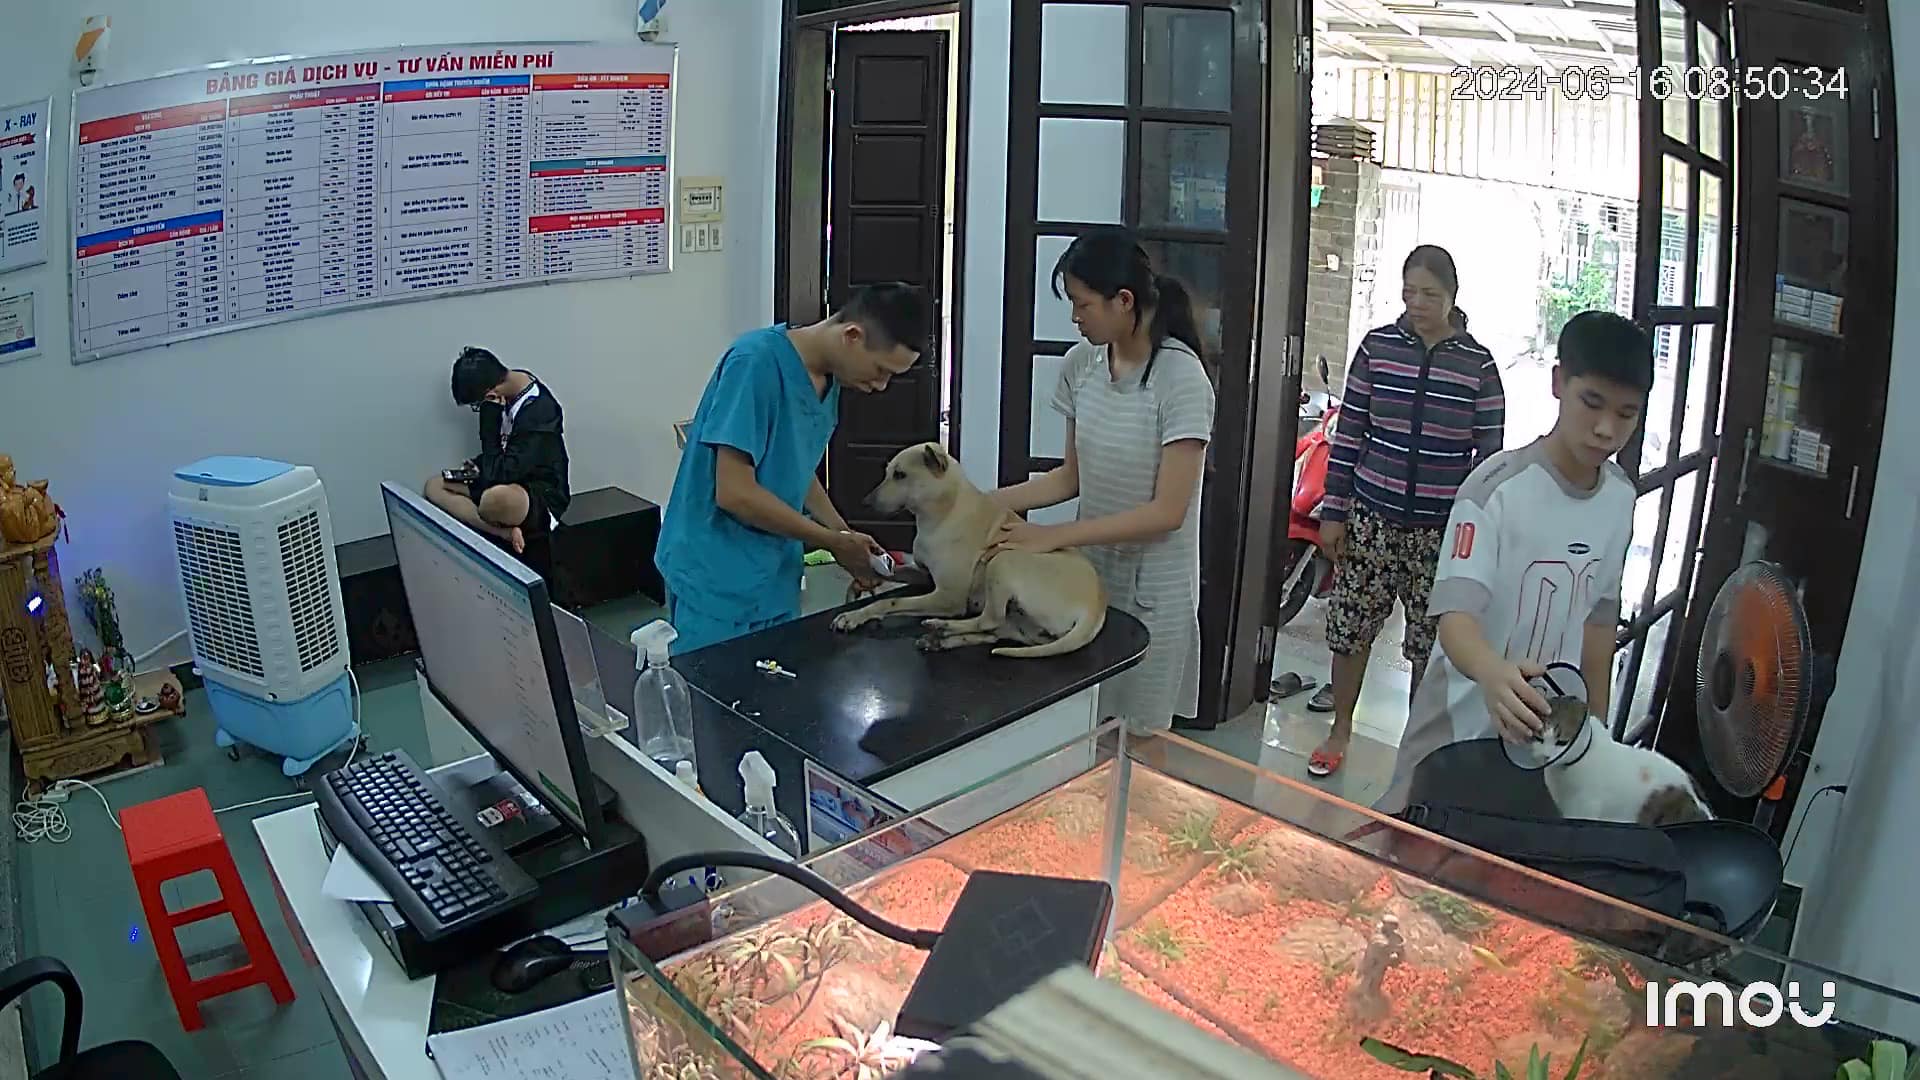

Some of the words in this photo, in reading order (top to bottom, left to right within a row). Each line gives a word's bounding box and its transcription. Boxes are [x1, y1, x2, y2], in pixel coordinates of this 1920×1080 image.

[206, 72, 259, 95] BẢNG
[264, 66, 297, 87] GIÁ
[303, 64, 348, 84] DỊCH
[354, 62, 378, 80] VỤ
[398, 57, 422, 74] TƯ
[426, 52, 463, 72] VẤN
[469, 50, 517, 70] MIỄN
[523, 51, 554, 68] PHÍ
[5, 119, 11, 131] X
[19, 112, 37, 128] RAY
